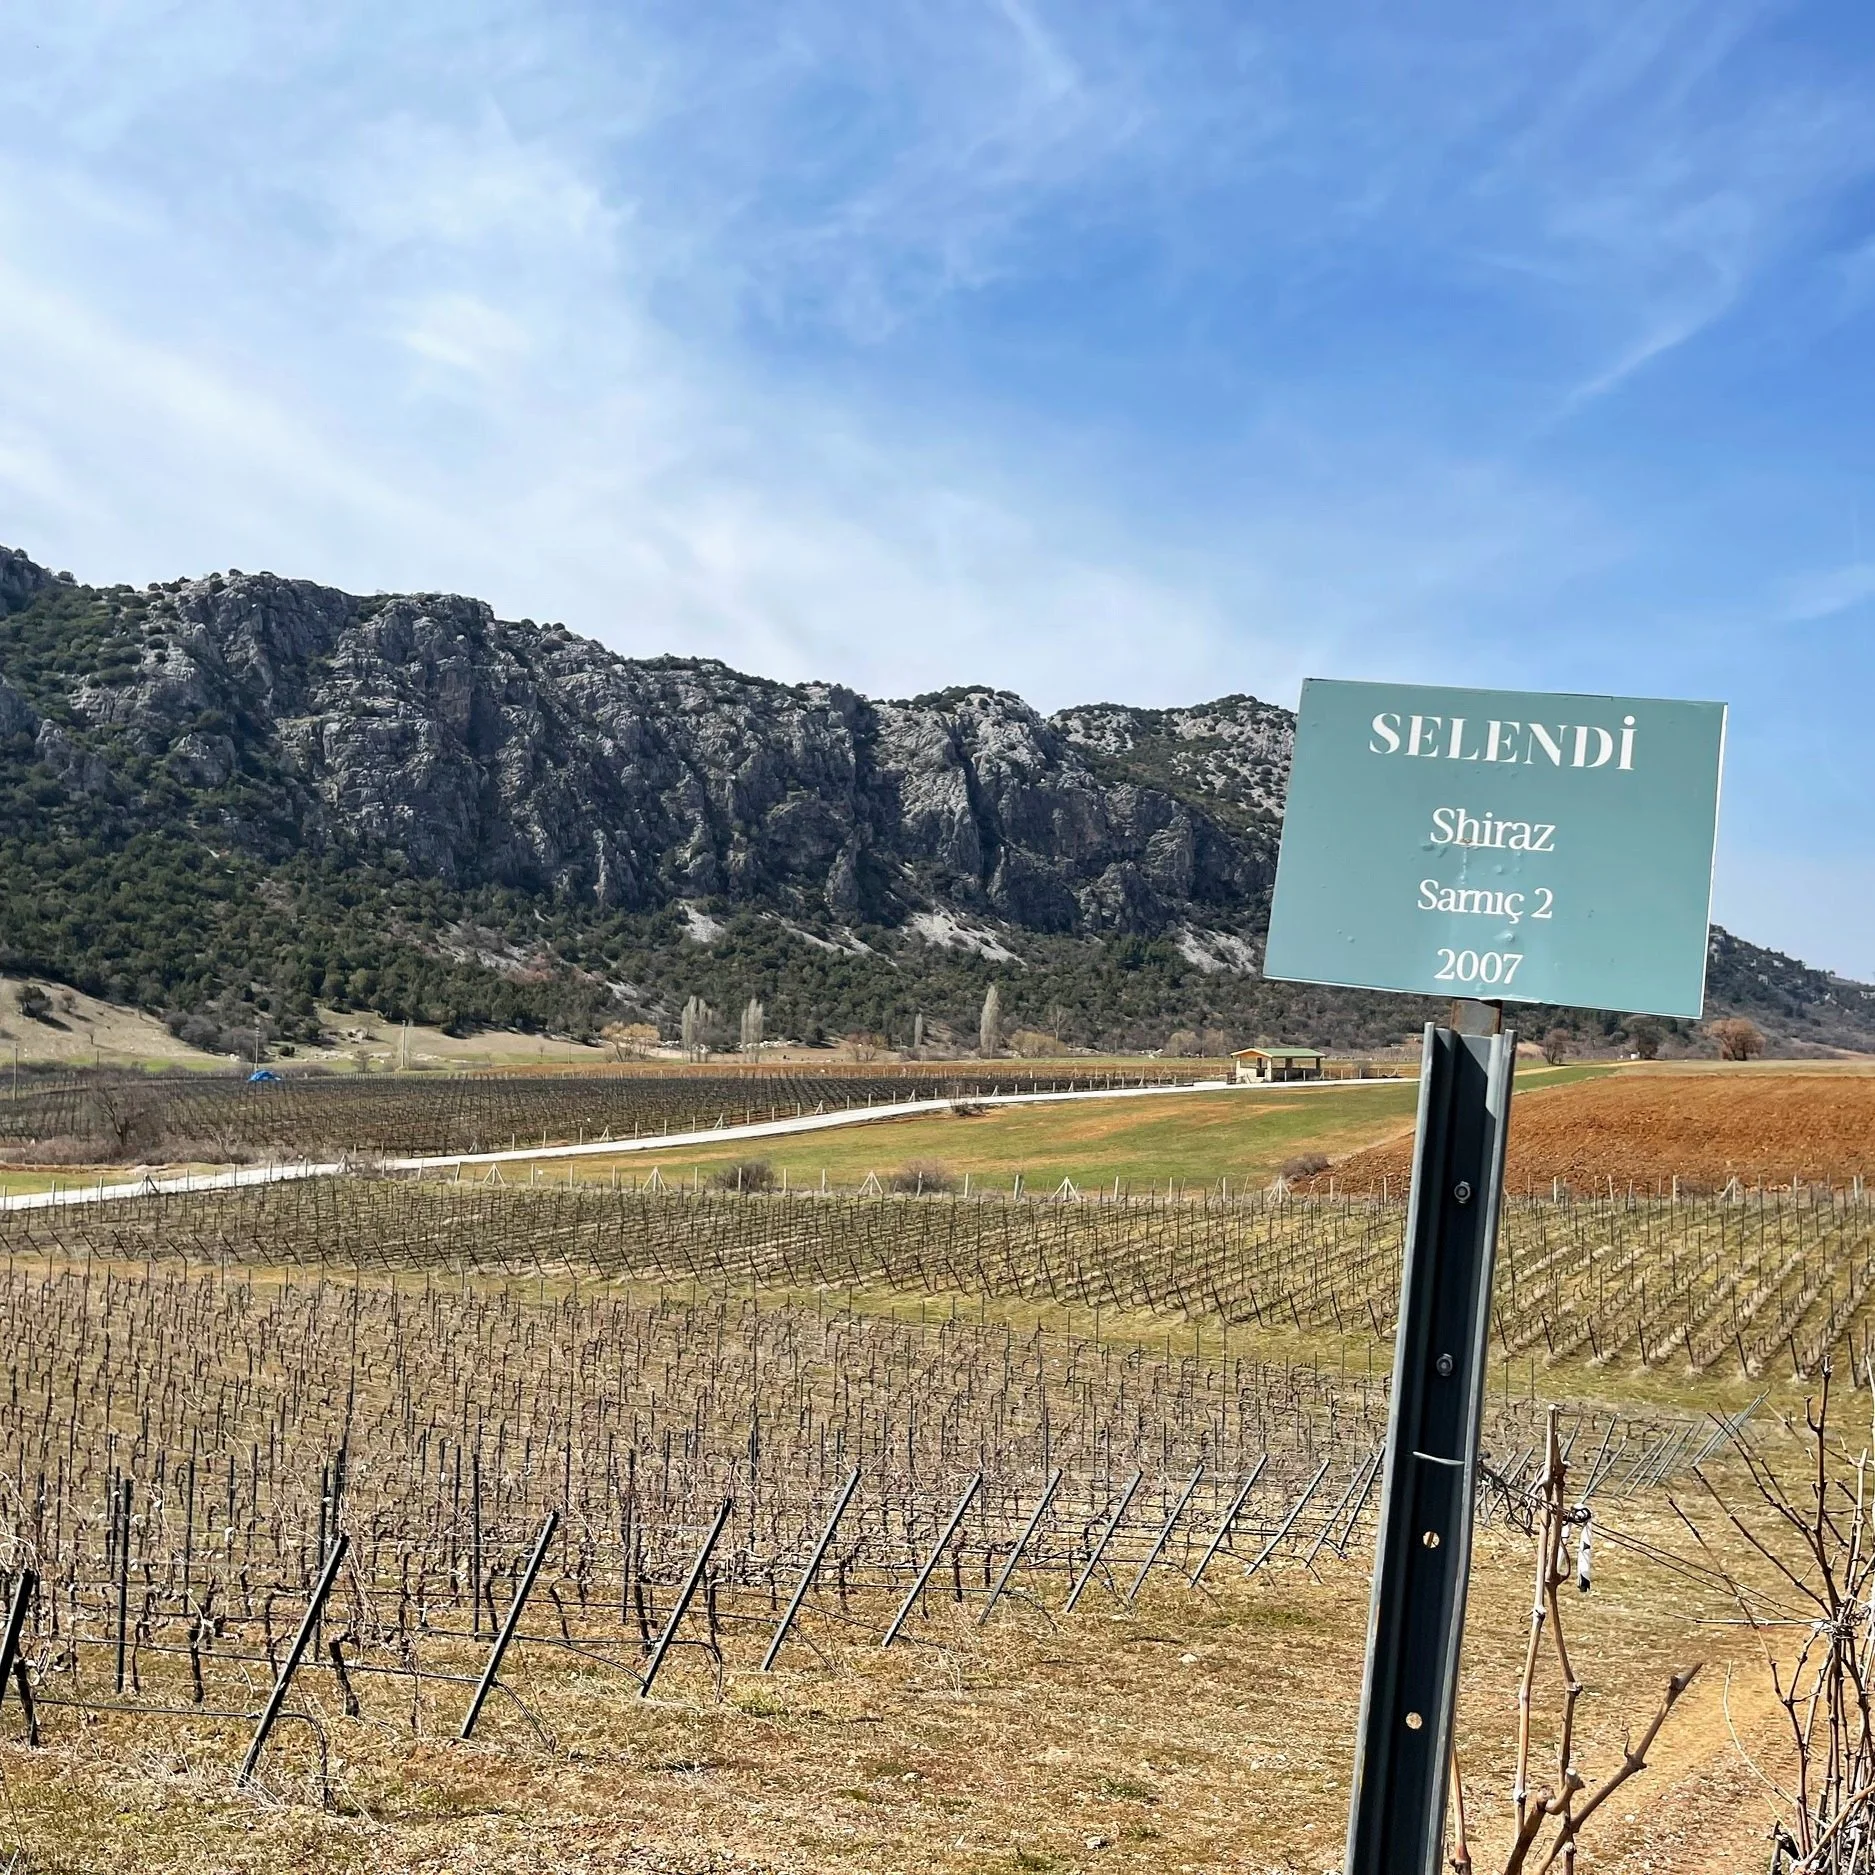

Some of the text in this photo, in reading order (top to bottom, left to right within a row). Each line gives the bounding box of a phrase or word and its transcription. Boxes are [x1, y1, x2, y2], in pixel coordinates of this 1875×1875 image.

[1369, 712, 1638, 771] SELENDİ
[1430, 807, 1556, 852] Shiraz
[1417, 878, 1554, 924] Sarnıç 2
[1434, 948, 1524, 985] 2007
